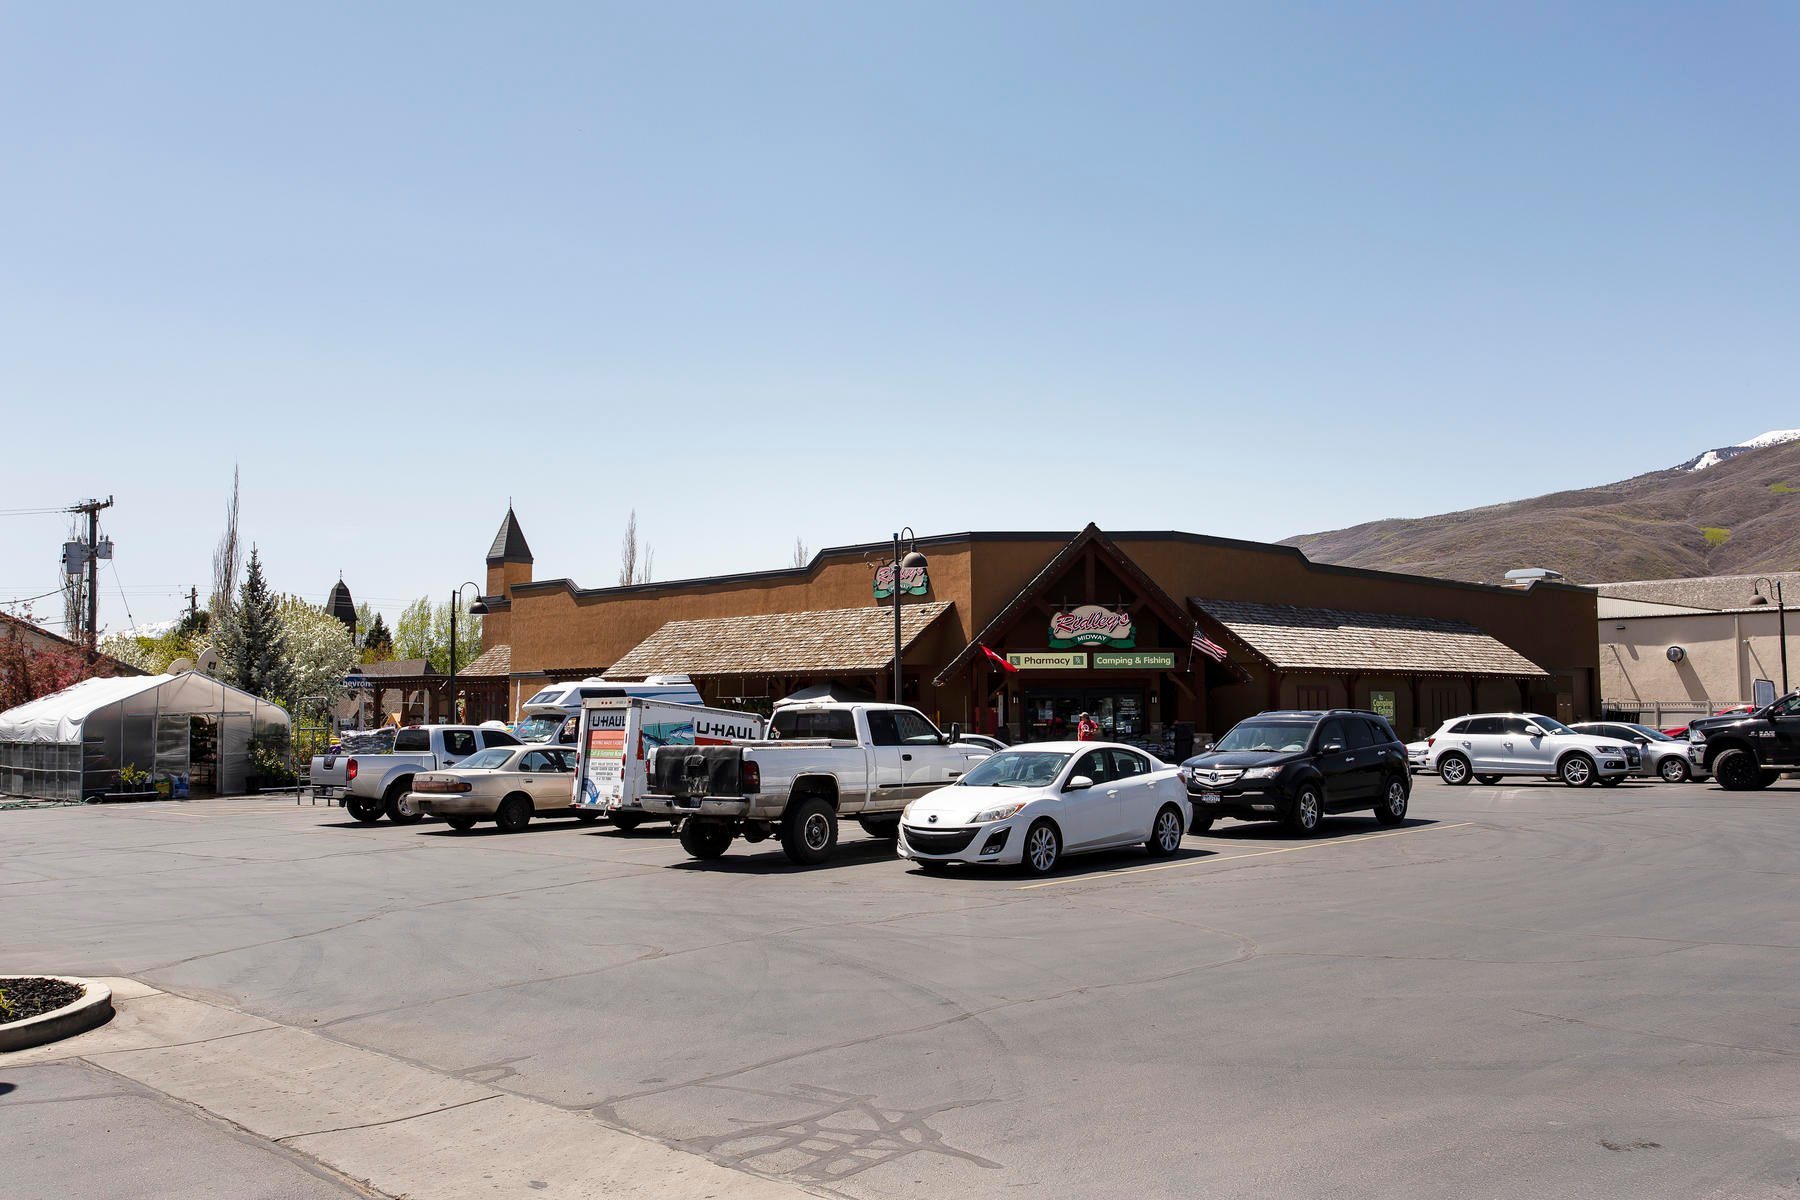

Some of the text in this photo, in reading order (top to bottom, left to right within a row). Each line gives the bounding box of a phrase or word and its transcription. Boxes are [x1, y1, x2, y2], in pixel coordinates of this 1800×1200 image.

[1077, 634, 1107, 642] MIDWAY
[1024, 656, 1070, 666] Pharmacy
[1096, 656, 1171, 665] Camping & Fishing
[592, 715, 626, 727] U-HAUL
[696, 720, 756, 740] U-HAUL
